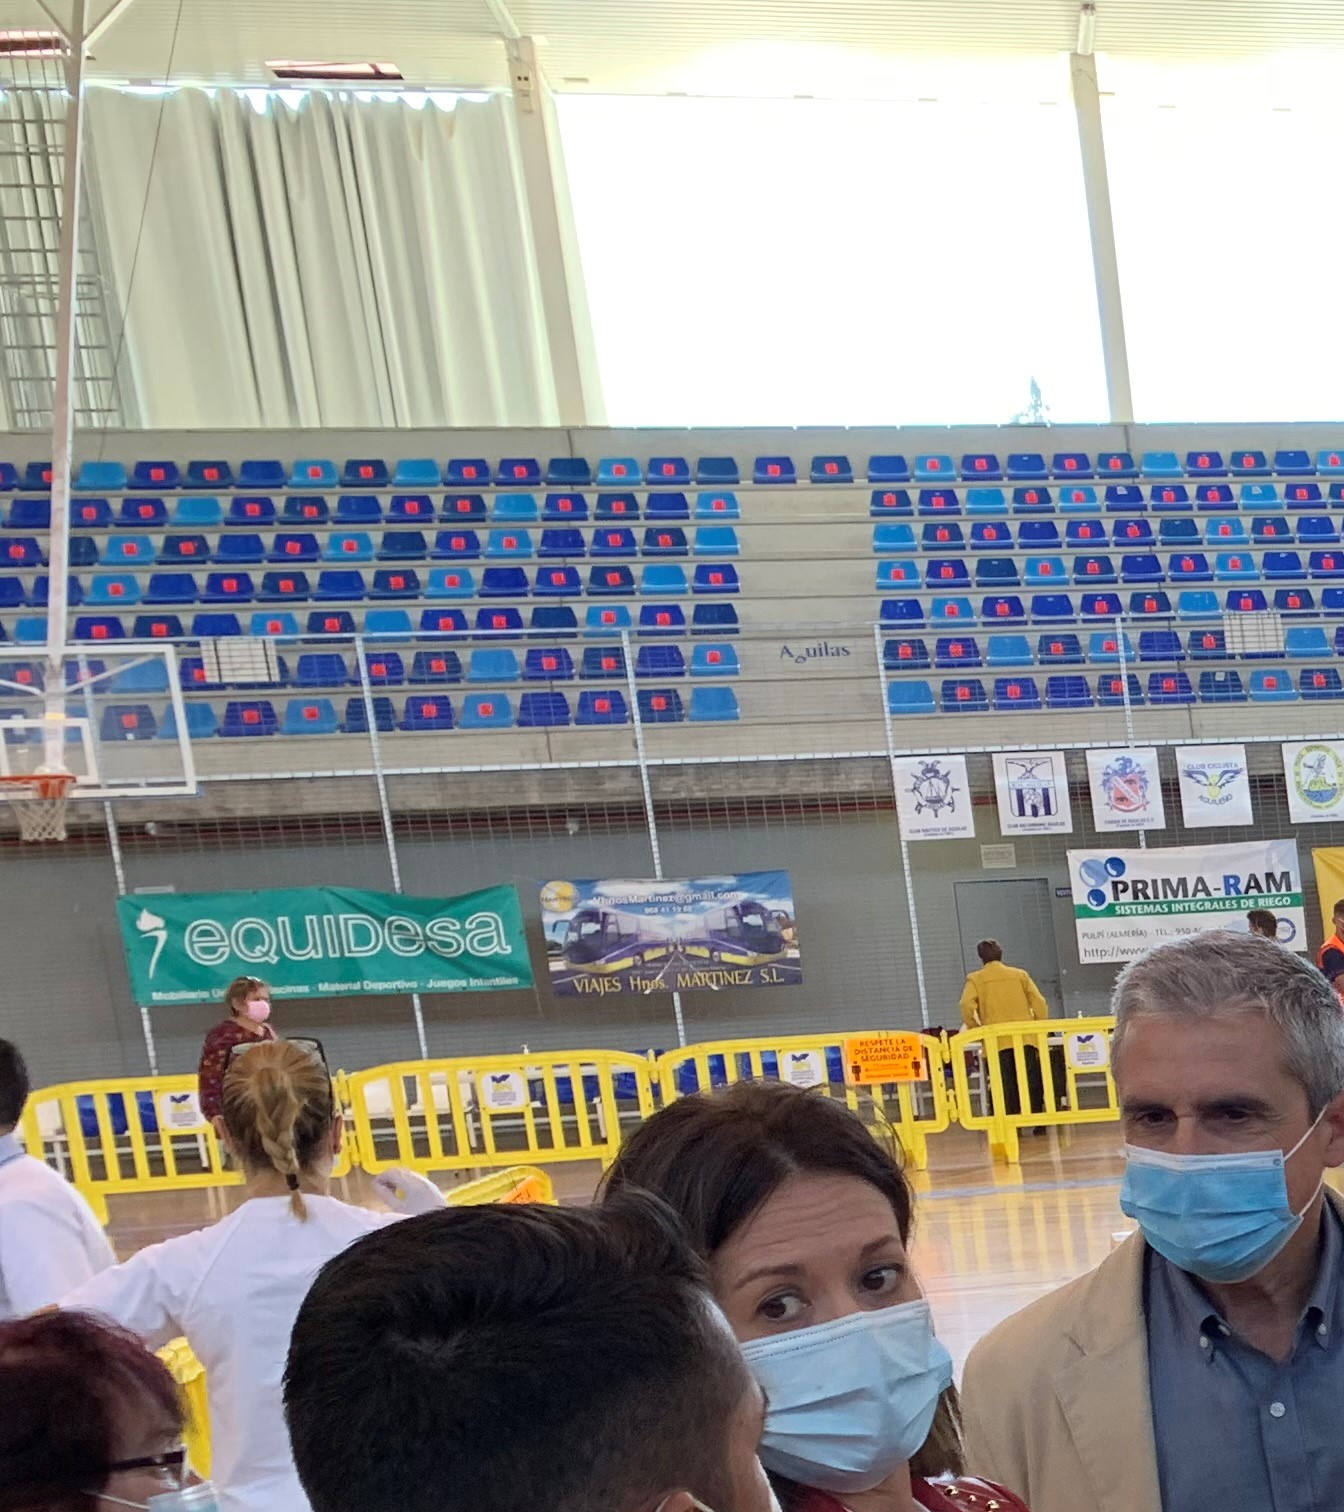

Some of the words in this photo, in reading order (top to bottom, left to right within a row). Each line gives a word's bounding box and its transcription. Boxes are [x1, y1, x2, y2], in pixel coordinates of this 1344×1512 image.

[1111, 870, 1293, 902] PRIMA-RAM
[1115, 903, 1169, 916] SISTEMAS
[1171, 899, 1238, 913] INTEGRALES
[1240, 898, 1255, 909] DE
[1257, 896, 1292, 908] RIEGO
[318, 979, 361, 992] Material
[362, 977, 418, 992] Deportivo
[426, 977, 467, 990] Juegos
[573, 976, 622, 996] VIAJES
[760, 967, 785, 984] S.L.
